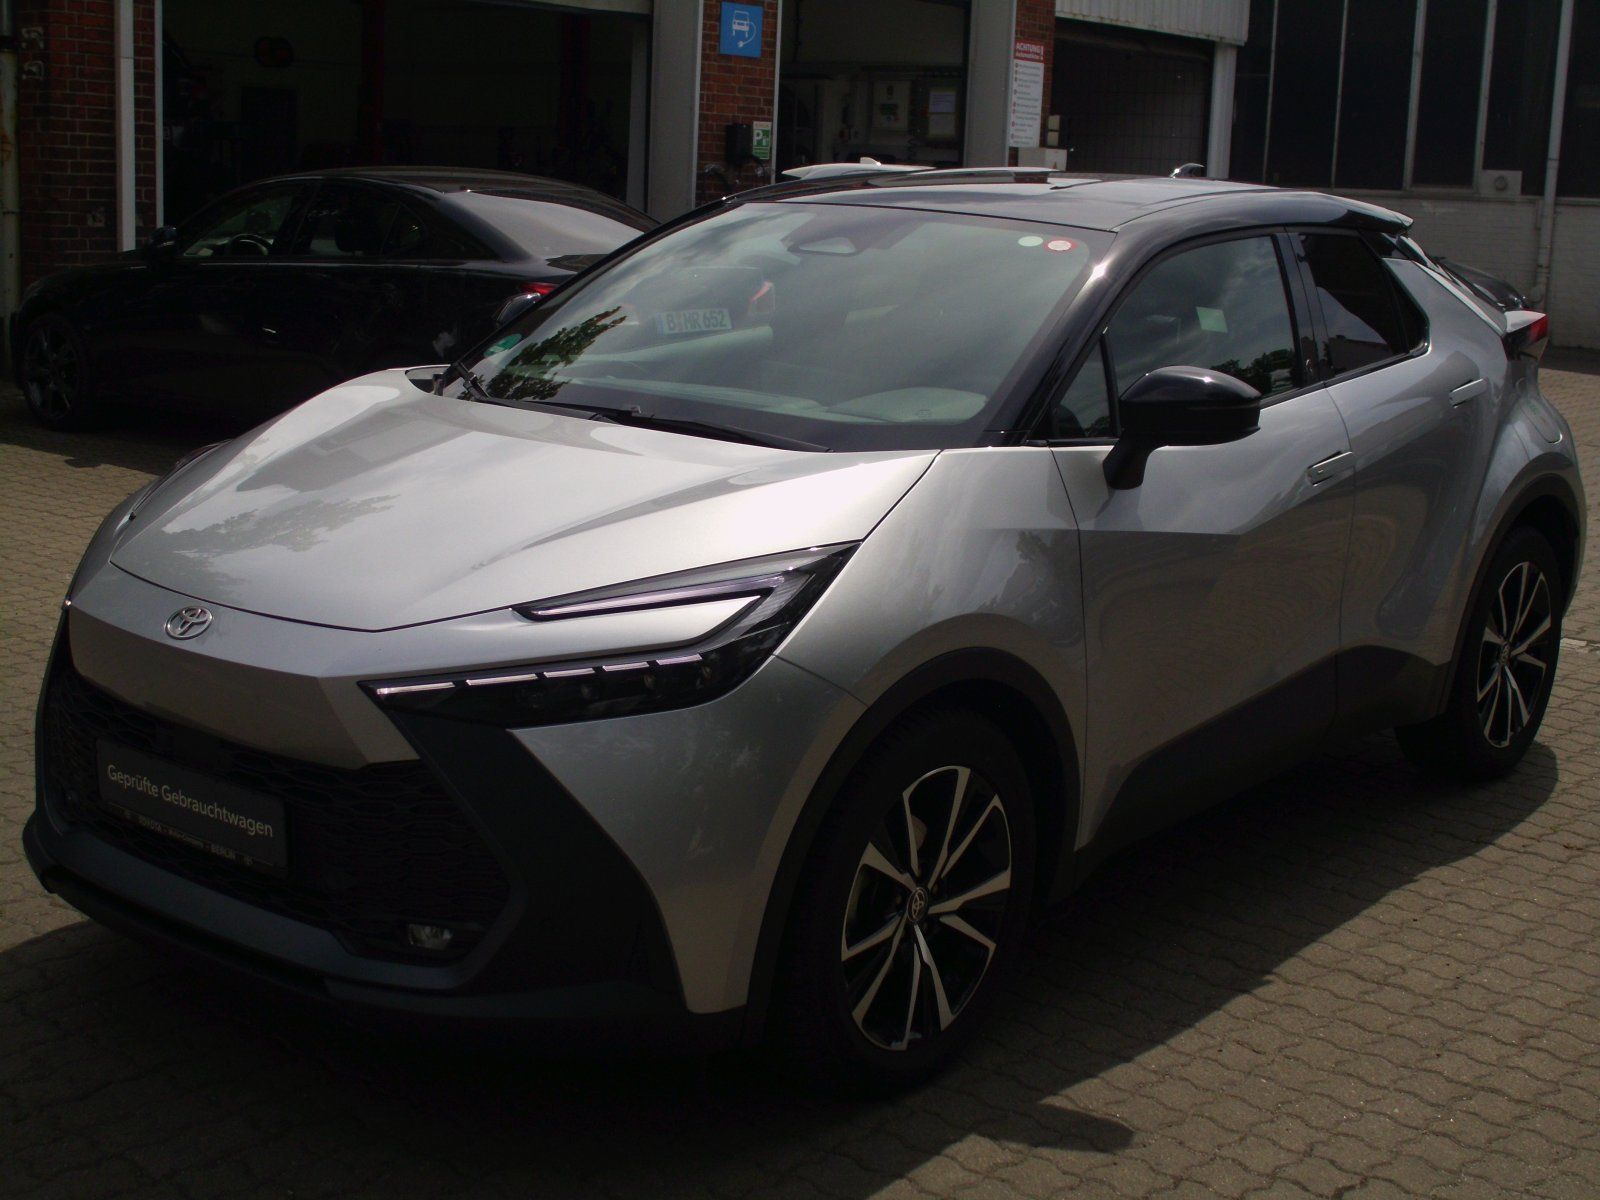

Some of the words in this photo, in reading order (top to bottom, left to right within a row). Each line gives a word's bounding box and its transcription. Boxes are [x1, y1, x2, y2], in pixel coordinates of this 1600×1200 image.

[703, 310, 727, 328] 652
[106, 764, 159, 798] Geprüfte
[160, 784, 273, 838] Gebrauchtwagen
